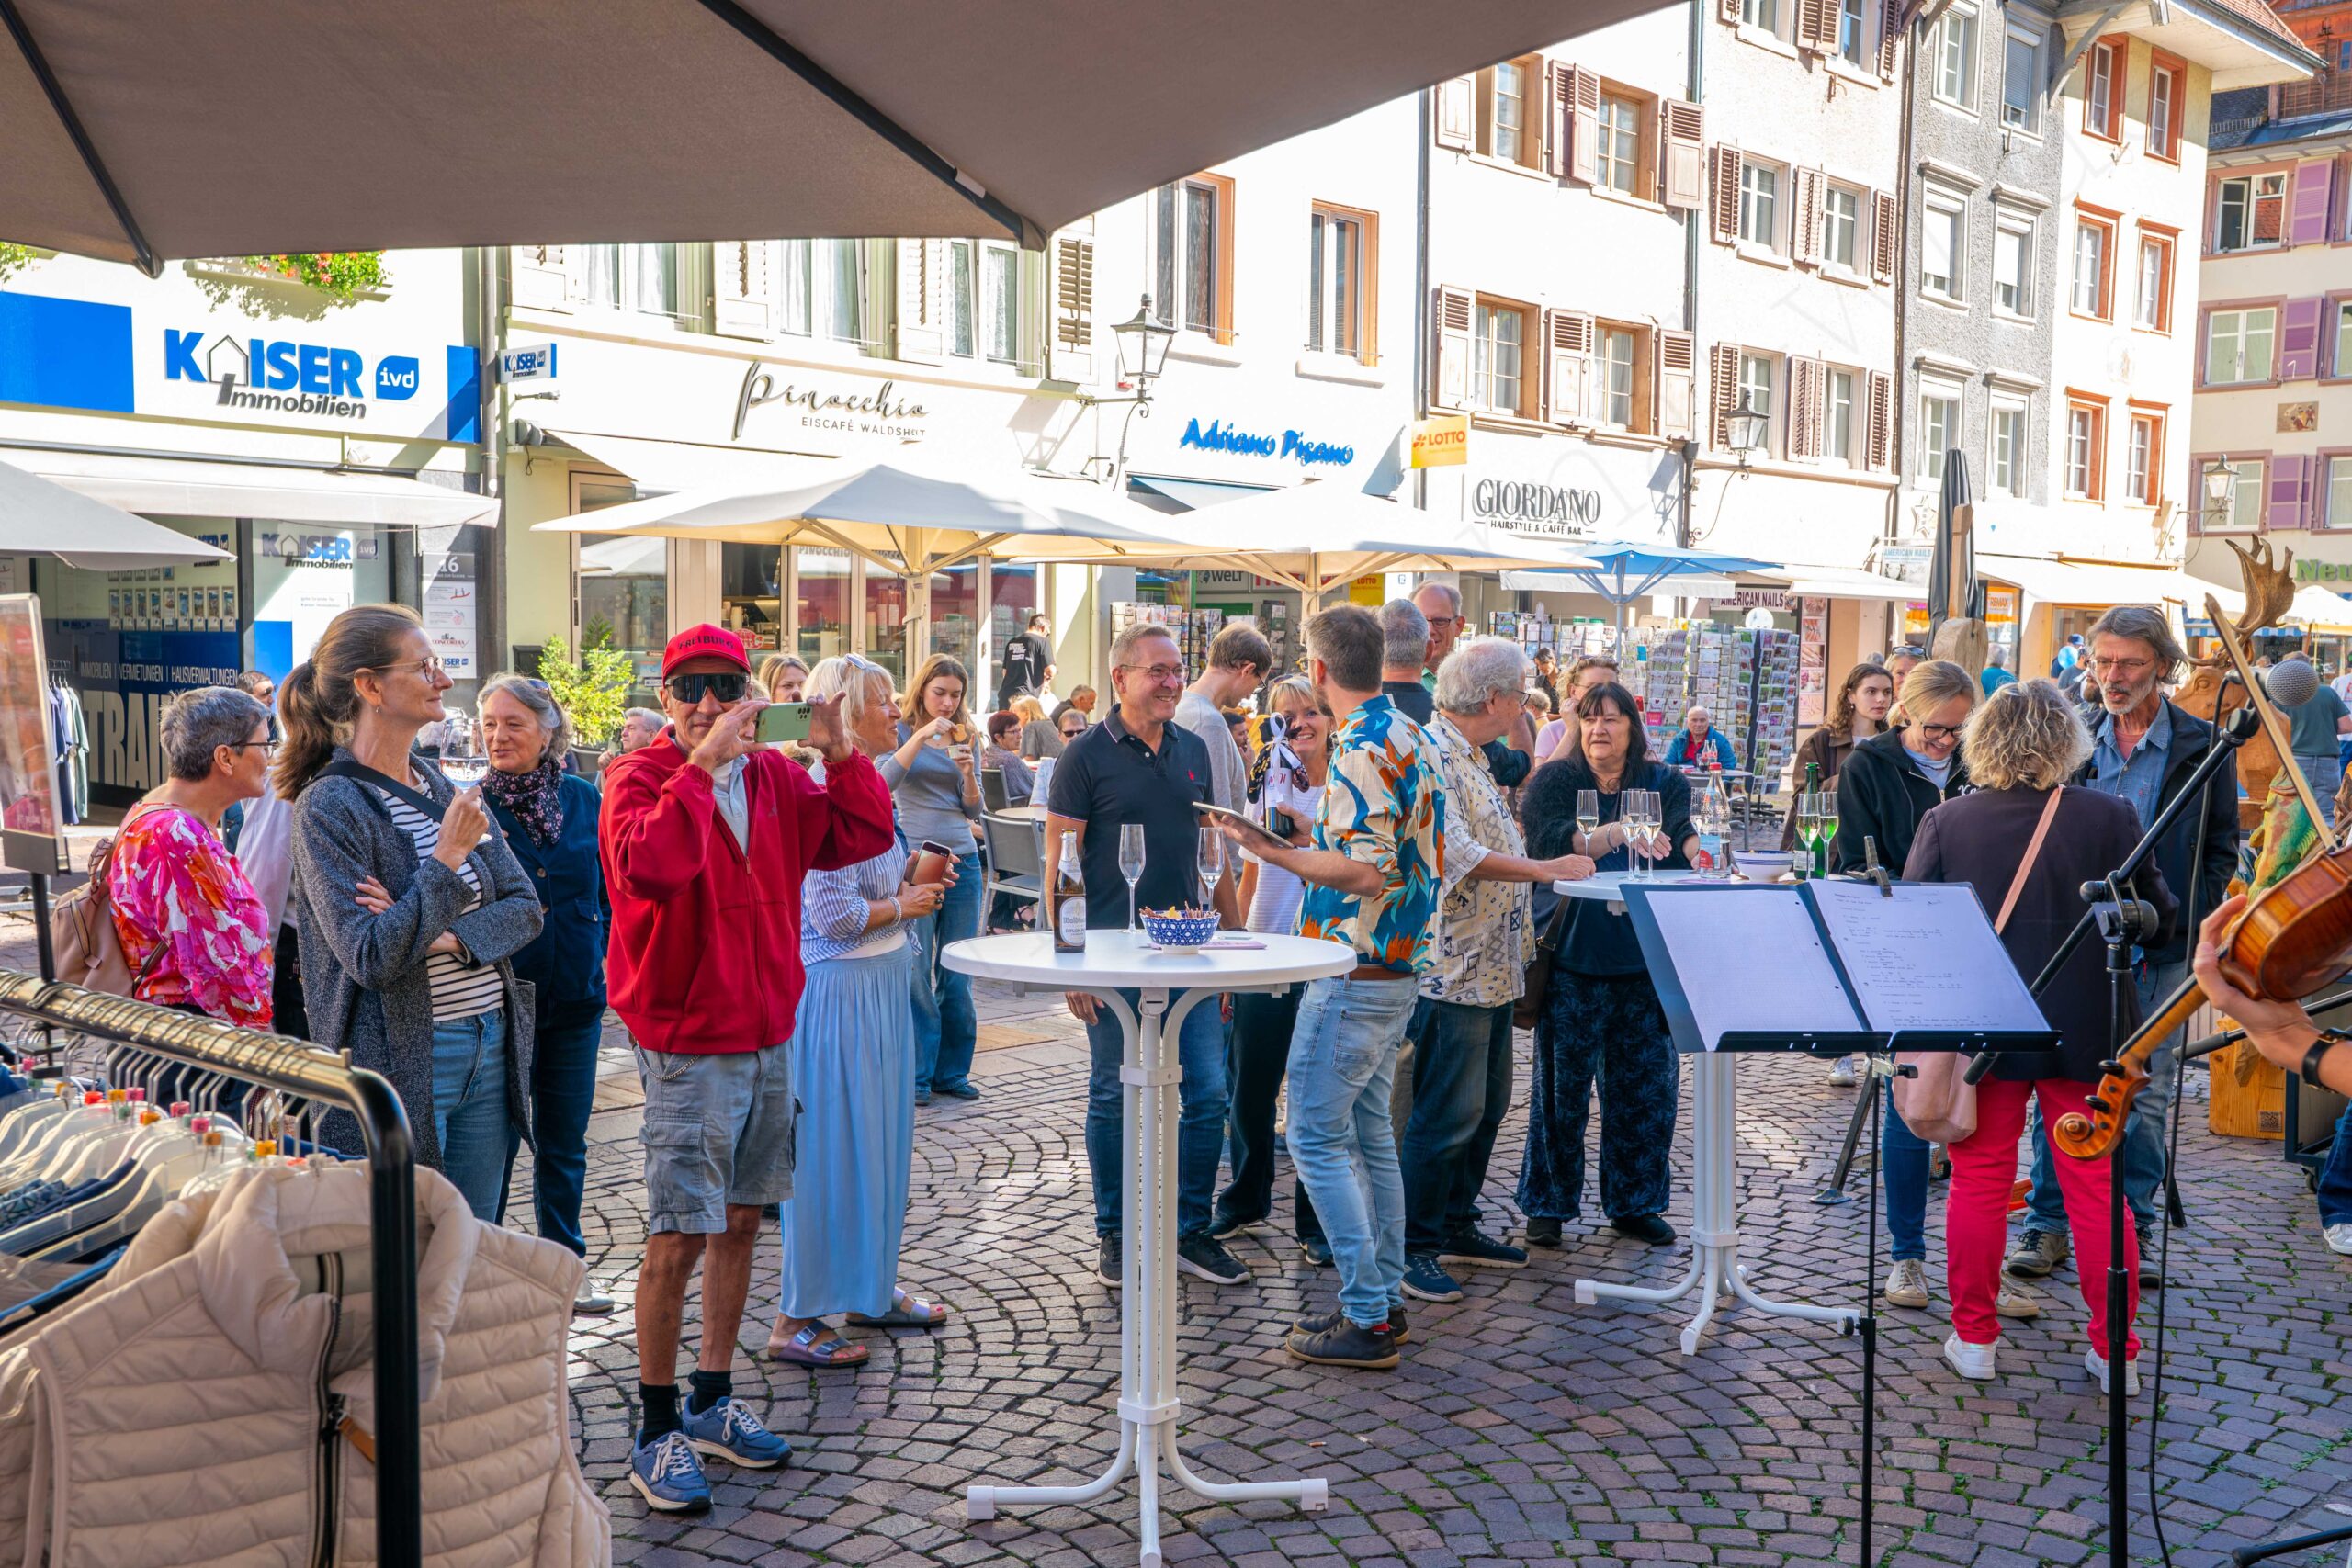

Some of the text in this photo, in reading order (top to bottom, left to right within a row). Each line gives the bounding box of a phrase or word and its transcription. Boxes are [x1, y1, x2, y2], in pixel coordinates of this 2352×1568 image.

[379, 367, 414, 389] ivd
[217, 373, 367, 419] Immobilien
[801, 416, 854, 432] EISCAFÉ
[1179, 417, 1354, 466] Adriano Pisano
[1429, 431, 1465, 446] LOTTO
[1474, 478, 1601, 525] GIORDANO
[1490, 520, 1532, 533] HAIRSTYLE
[1567, 526, 1582, 536] BAR
[284, 553, 354, 570] Immobilien
[439, 556, 459, 573] 16
[1357, 577, 1377, 586] LOTTO
[1721, 591, 1784, 607] AMERICAN NAILS
[678, 635, 735, 650] FREIBURG
[171, 666, 239, 686] HAUSVERWALTUNGEN
